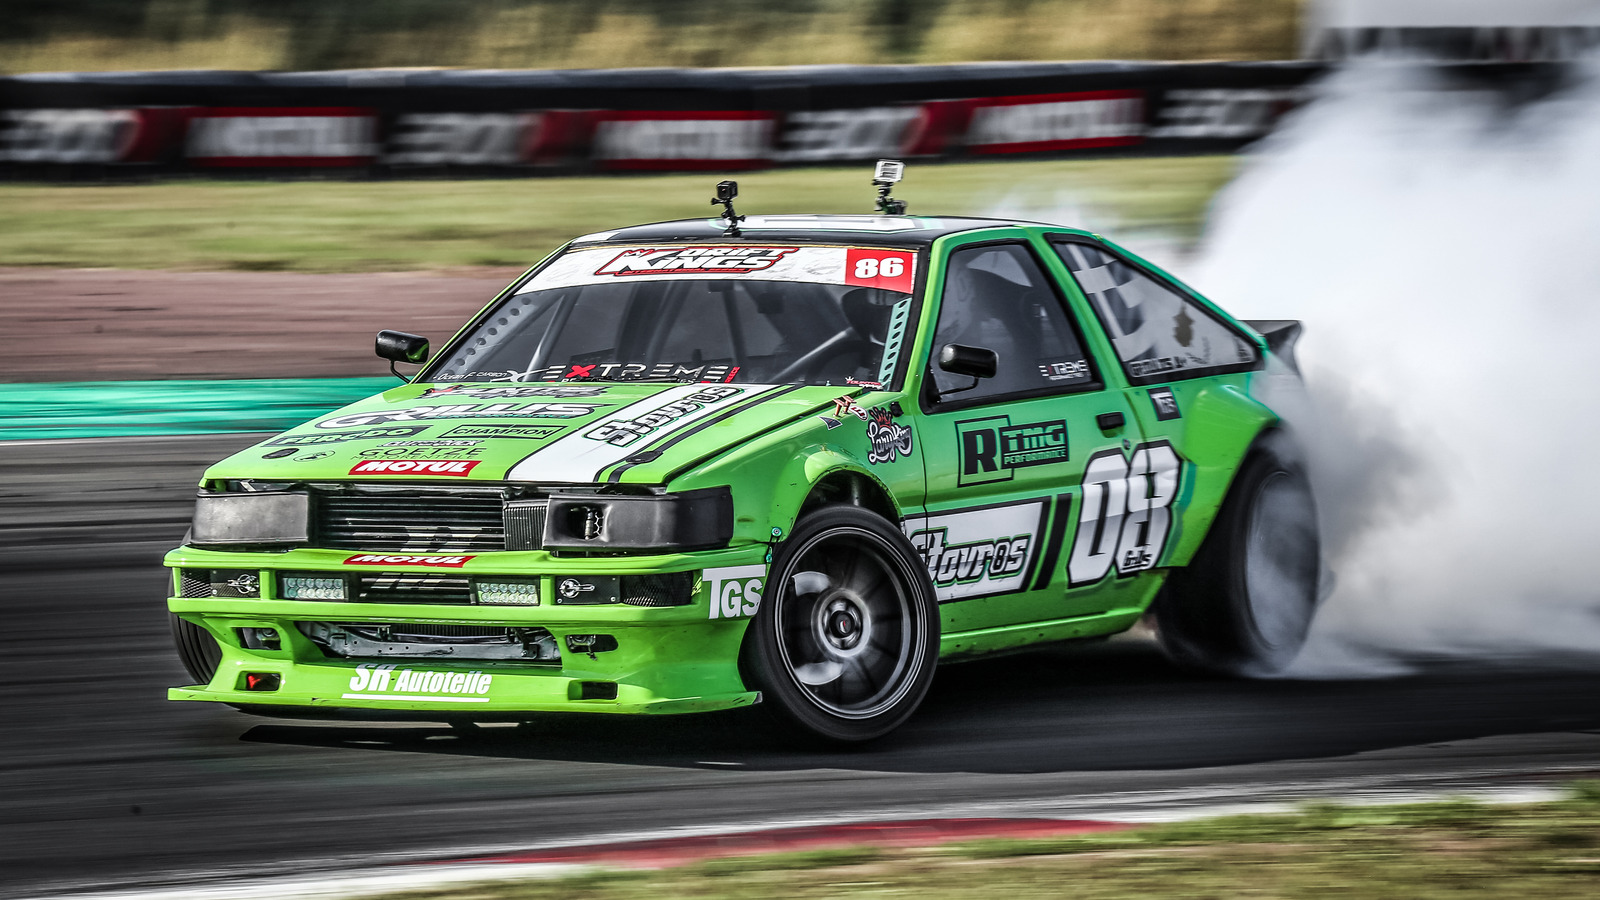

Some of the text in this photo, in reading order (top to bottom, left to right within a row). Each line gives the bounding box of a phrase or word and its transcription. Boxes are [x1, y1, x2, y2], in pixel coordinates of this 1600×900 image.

[597, 247, 780, 273] KINGS
[674, 247, 796, 257] DRIFT
[854, 256, 905, 279] 86
[542, 363, 729, 379] EXTREME
[452, 427, 551, 437] CHAMPION
[358, 447, 487, 457] GOETZE
[354, 460, 471, 473] MOTUL
[1068, 442, 1182, 587] 08
[350, 554, 466, 565] MOTUL
[702, 563, 767, 619] TGS
[349, 663, 493, 695] SR Autoteile
